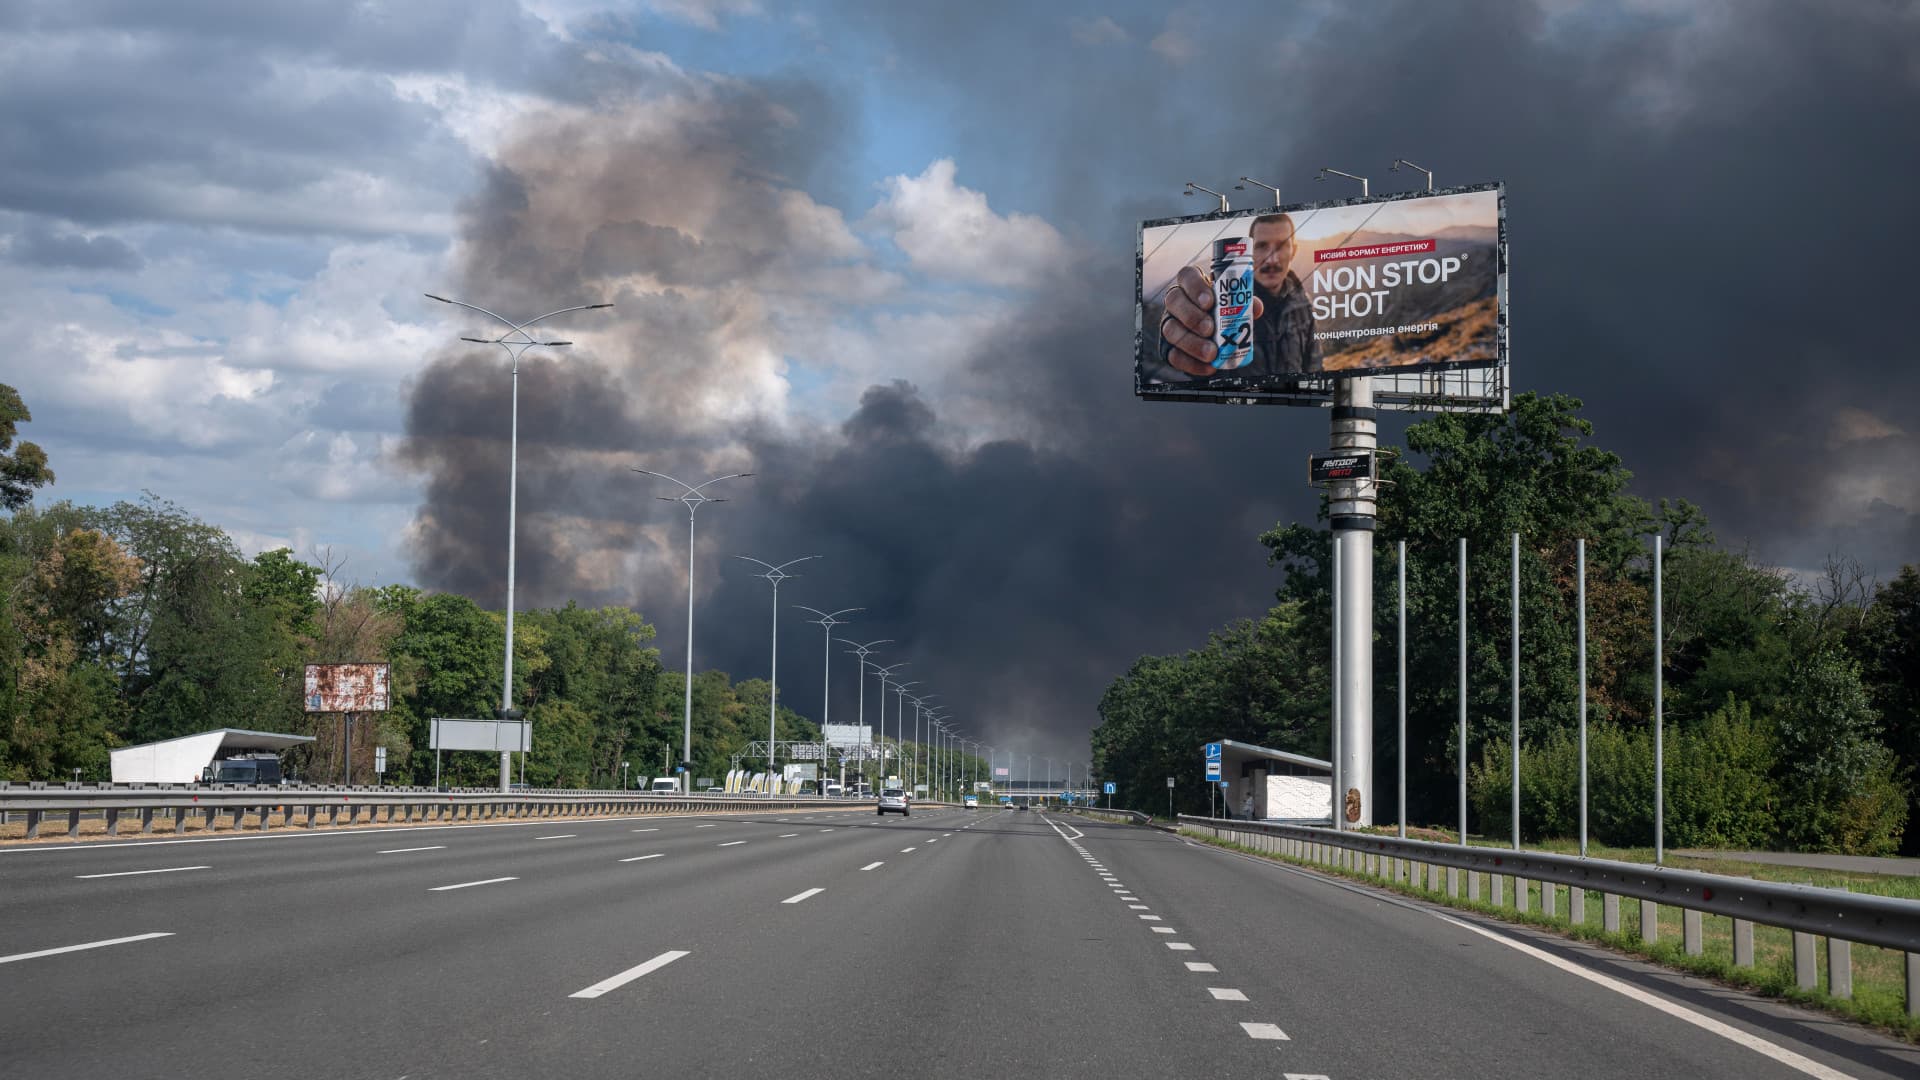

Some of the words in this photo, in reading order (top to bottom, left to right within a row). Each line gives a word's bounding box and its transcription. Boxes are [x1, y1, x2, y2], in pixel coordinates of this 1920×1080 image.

[1320, 250, 1347, 260] НОВИЙ
[1348, 247, 1380, 257] ФОРМАТ
[1381, 242, 1429, 254] ЕНЕРГЕТИКУ
[1220, 278, 1248, 291] NON
[1313, 265, 1375, 293] NON
[1219, 291, 1252, 306] STOP
[1312, 290, 1390, 320] SHOT
[1221, 307, 1238, 316] SHOT
[1313, 326, 1395, 340] концентрована
[1397, 321, 1439, 335] енергія
